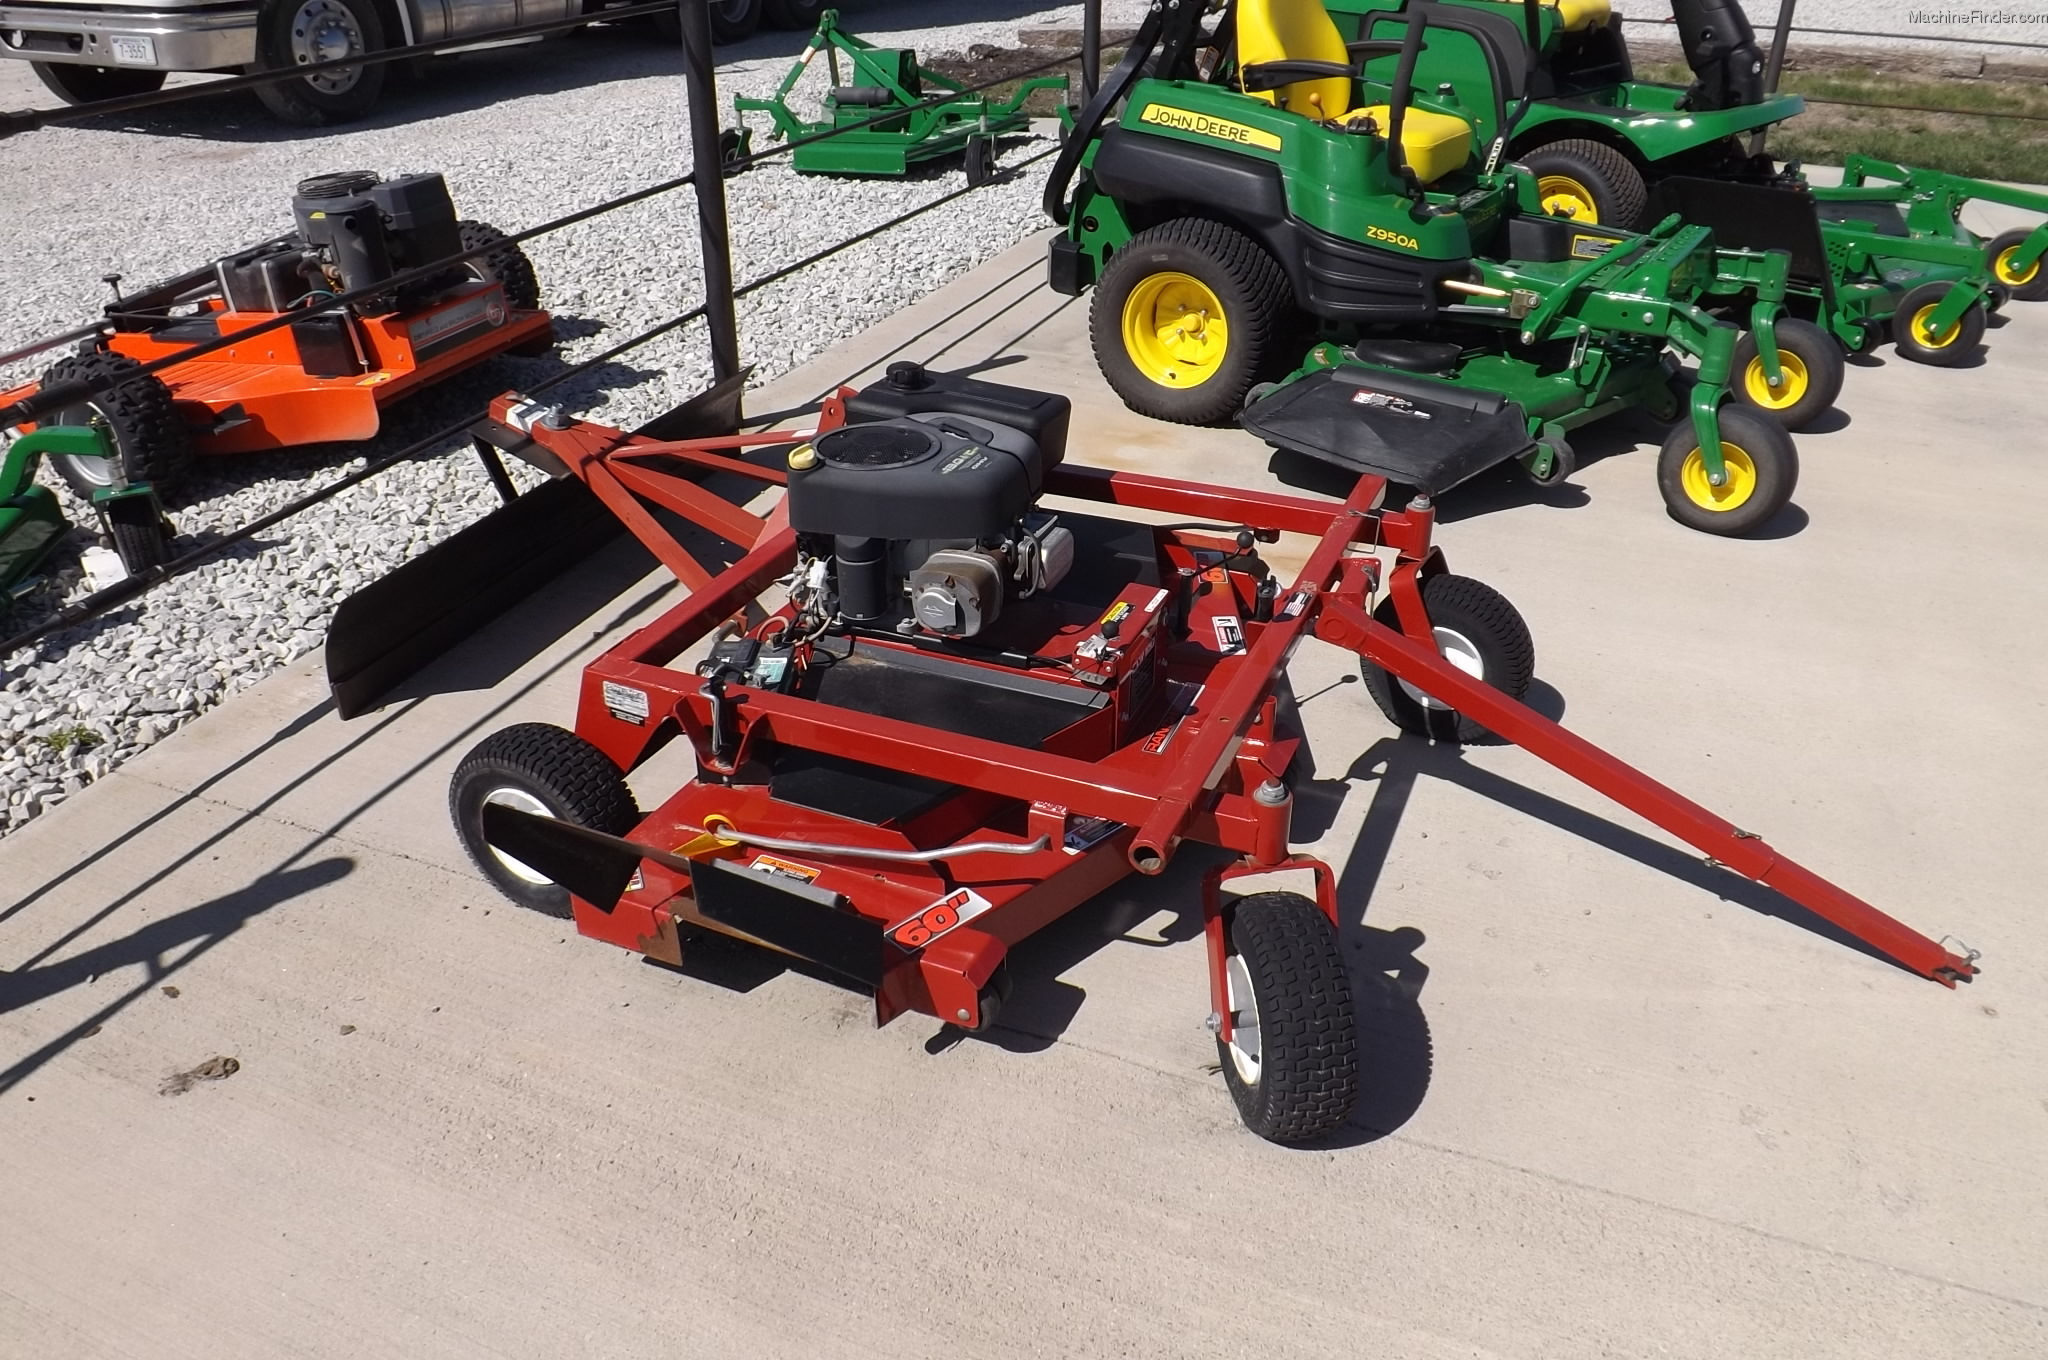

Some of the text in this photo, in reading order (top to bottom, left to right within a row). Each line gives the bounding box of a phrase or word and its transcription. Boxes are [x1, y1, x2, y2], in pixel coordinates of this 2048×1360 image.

[1150, 107, 1250, 141] JOHN DEERE
[1367, 225, 1418, 251] Z950A
[894, 889, 970, 948] 60"
